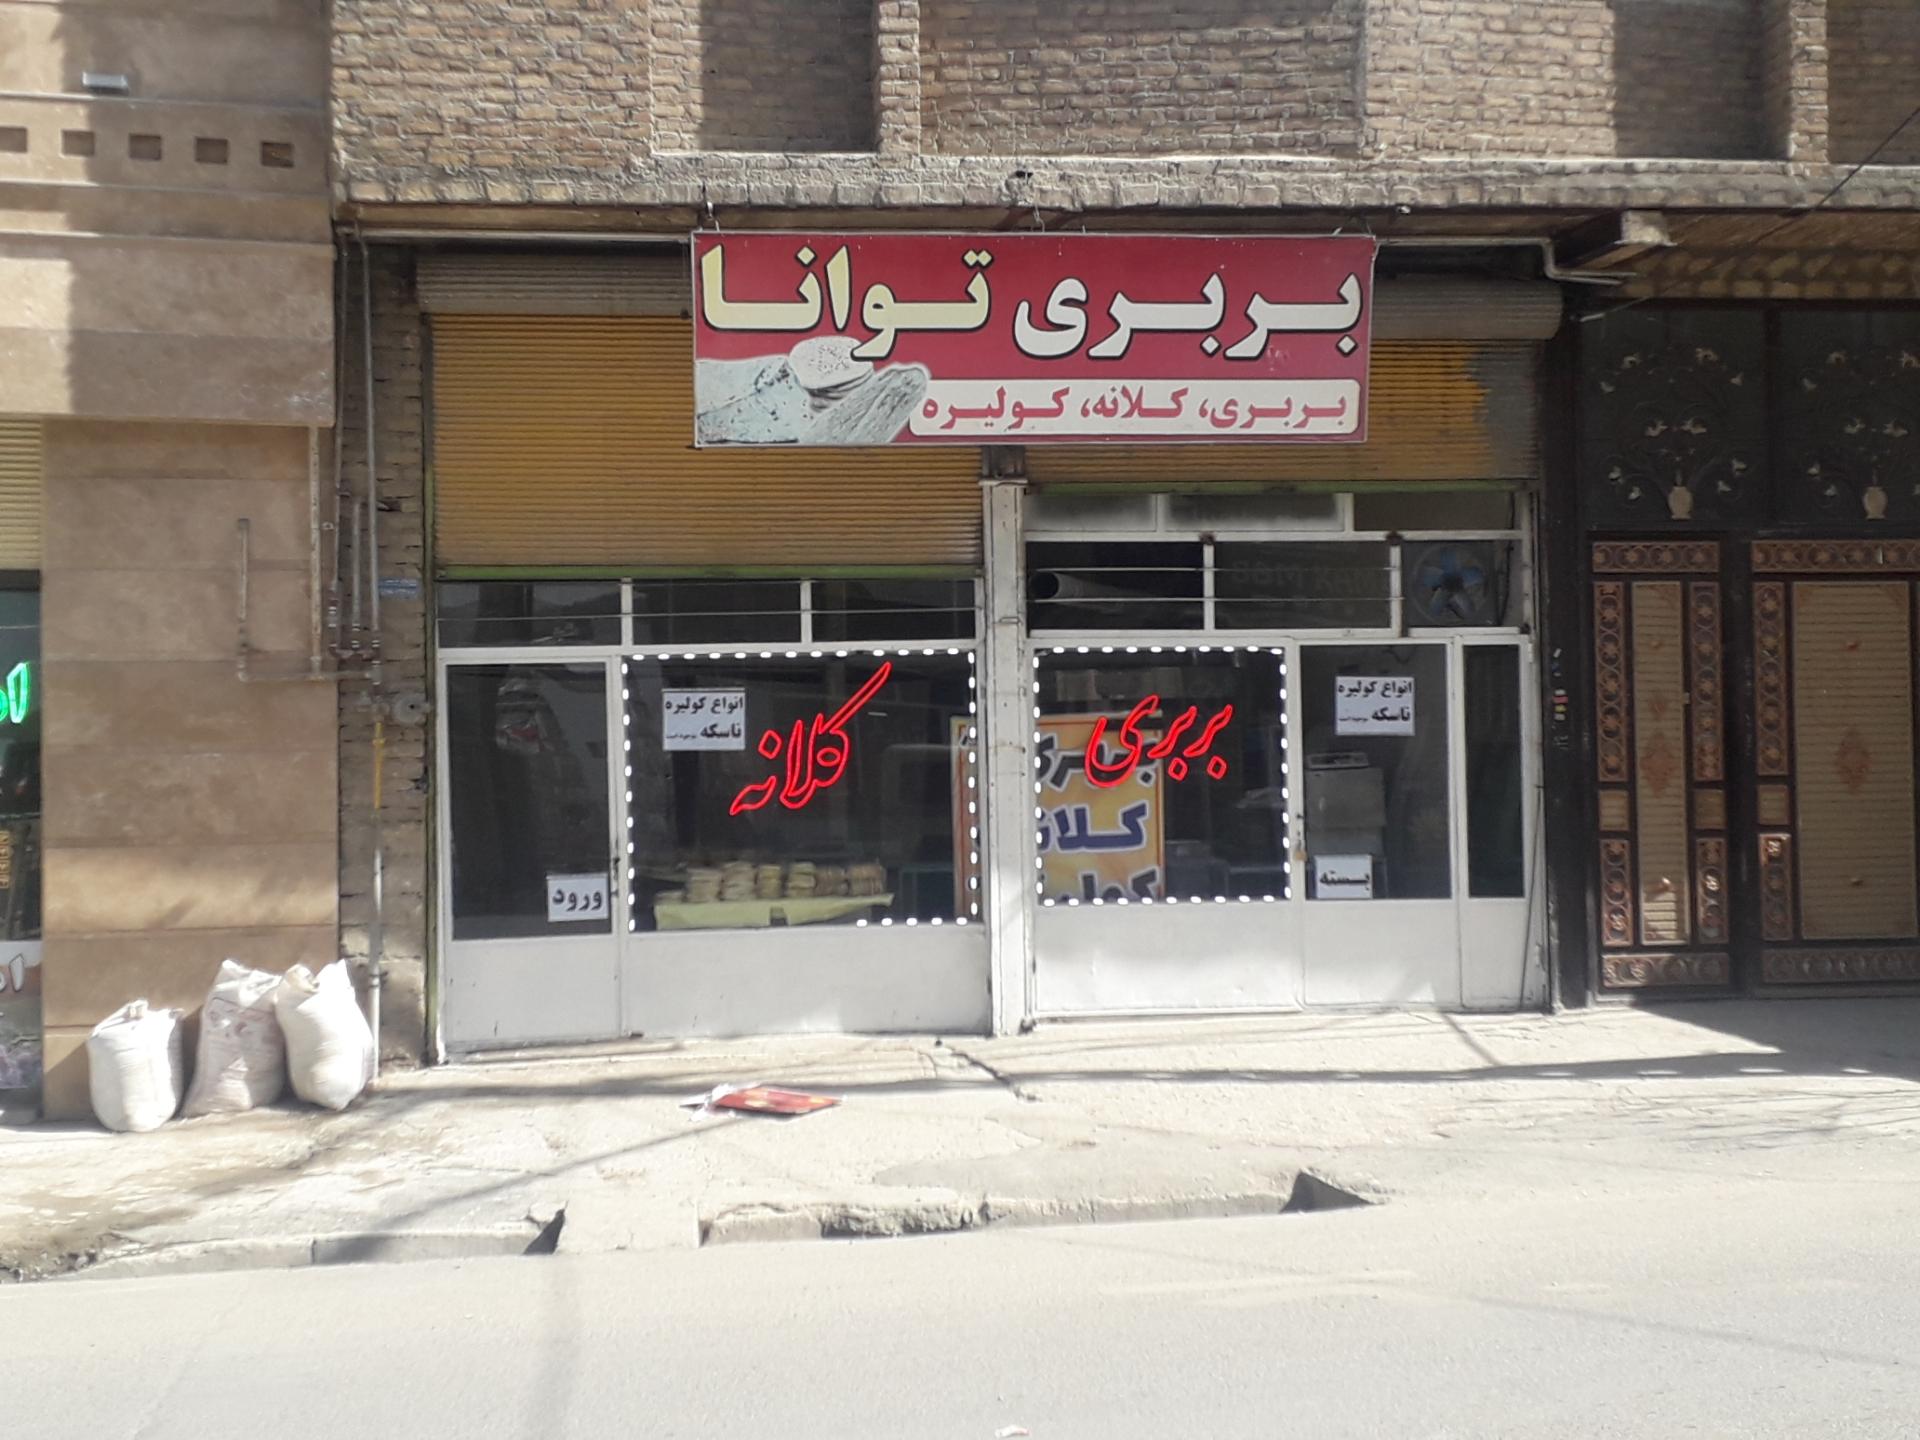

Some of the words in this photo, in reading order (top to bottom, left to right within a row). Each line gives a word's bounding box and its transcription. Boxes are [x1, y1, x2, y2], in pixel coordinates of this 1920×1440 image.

[700, 243, 992, 361] توانا
[1012, 272, 1363, 359] بربری
[922, 385, 1070, 430] کولیره
[665, 696, 707, 714] کولیره
[710, 695, 744, 714] انواع
[1338, 681, 1378, 698] کولیره
[1381, 680, 1412, 698] انواع
[729, 661, 892, 816] کلانه
[1084, 695, 1233, 788] بربری
[552, 889, 602, 912] ورود
